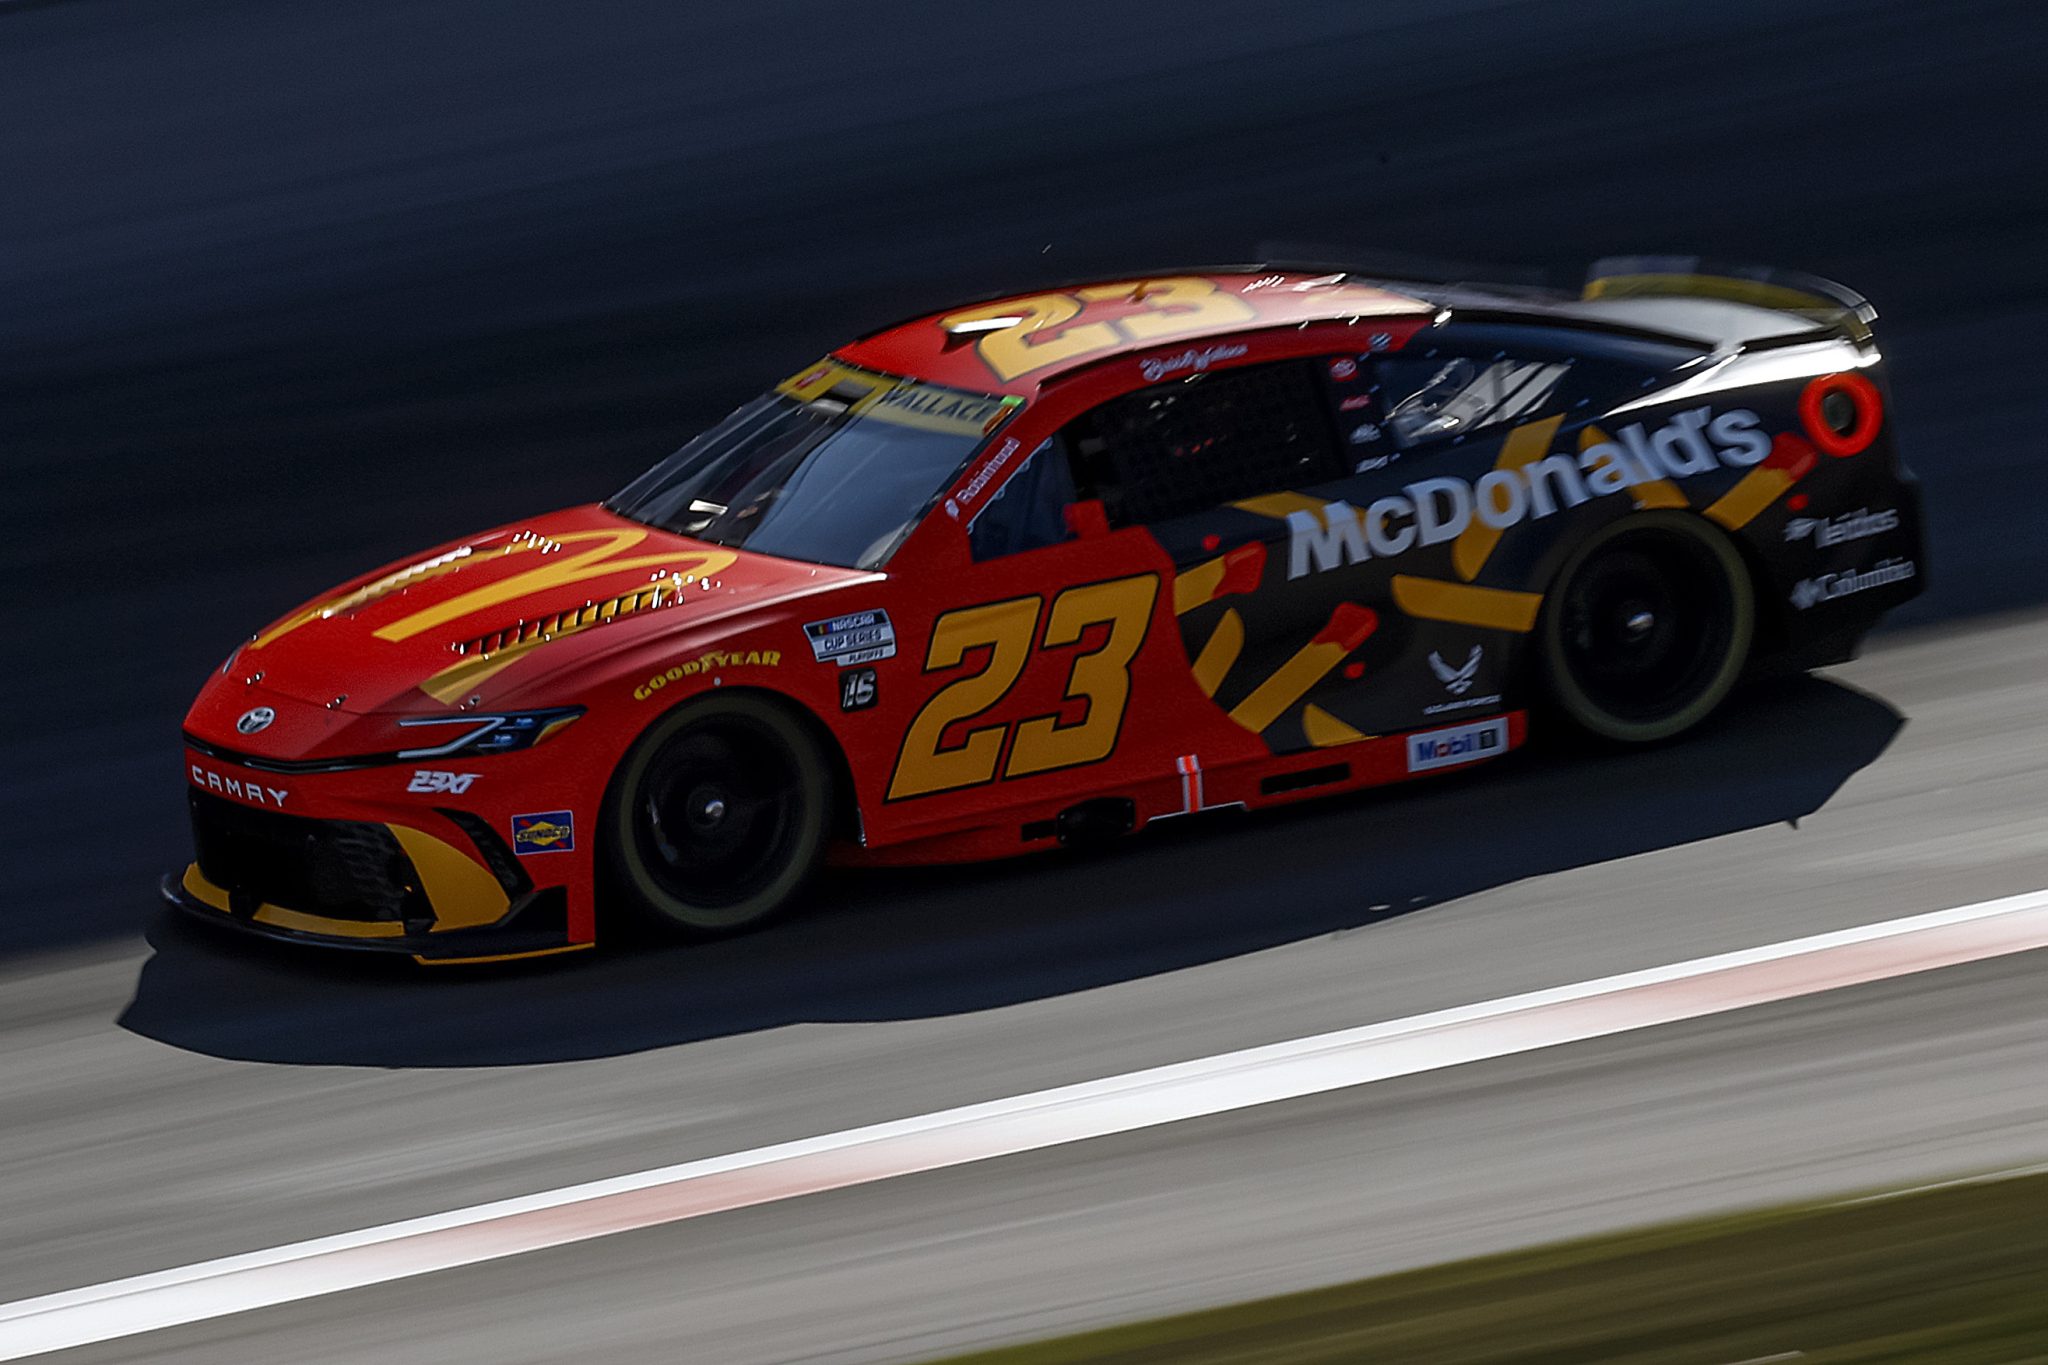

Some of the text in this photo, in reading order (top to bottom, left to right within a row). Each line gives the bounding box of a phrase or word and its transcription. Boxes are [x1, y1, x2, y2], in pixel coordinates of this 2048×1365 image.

[939, 275, 1259, 384] 23
[1286, 406, 1773, 581] McDonald's
[832, 613, 875, 632] NASCAR
[823, 634, 846, 652] CUP
[633, 650, 781, 700] GOODYEAR
[842, 671, 875, 708] 16
[883, 571, 1162, 805] 23
[1417, 733, 1475, 762] Mobil
[192, 765, 289, 807] CAMRY
[516, 825, 571, 844] SUNOCO
